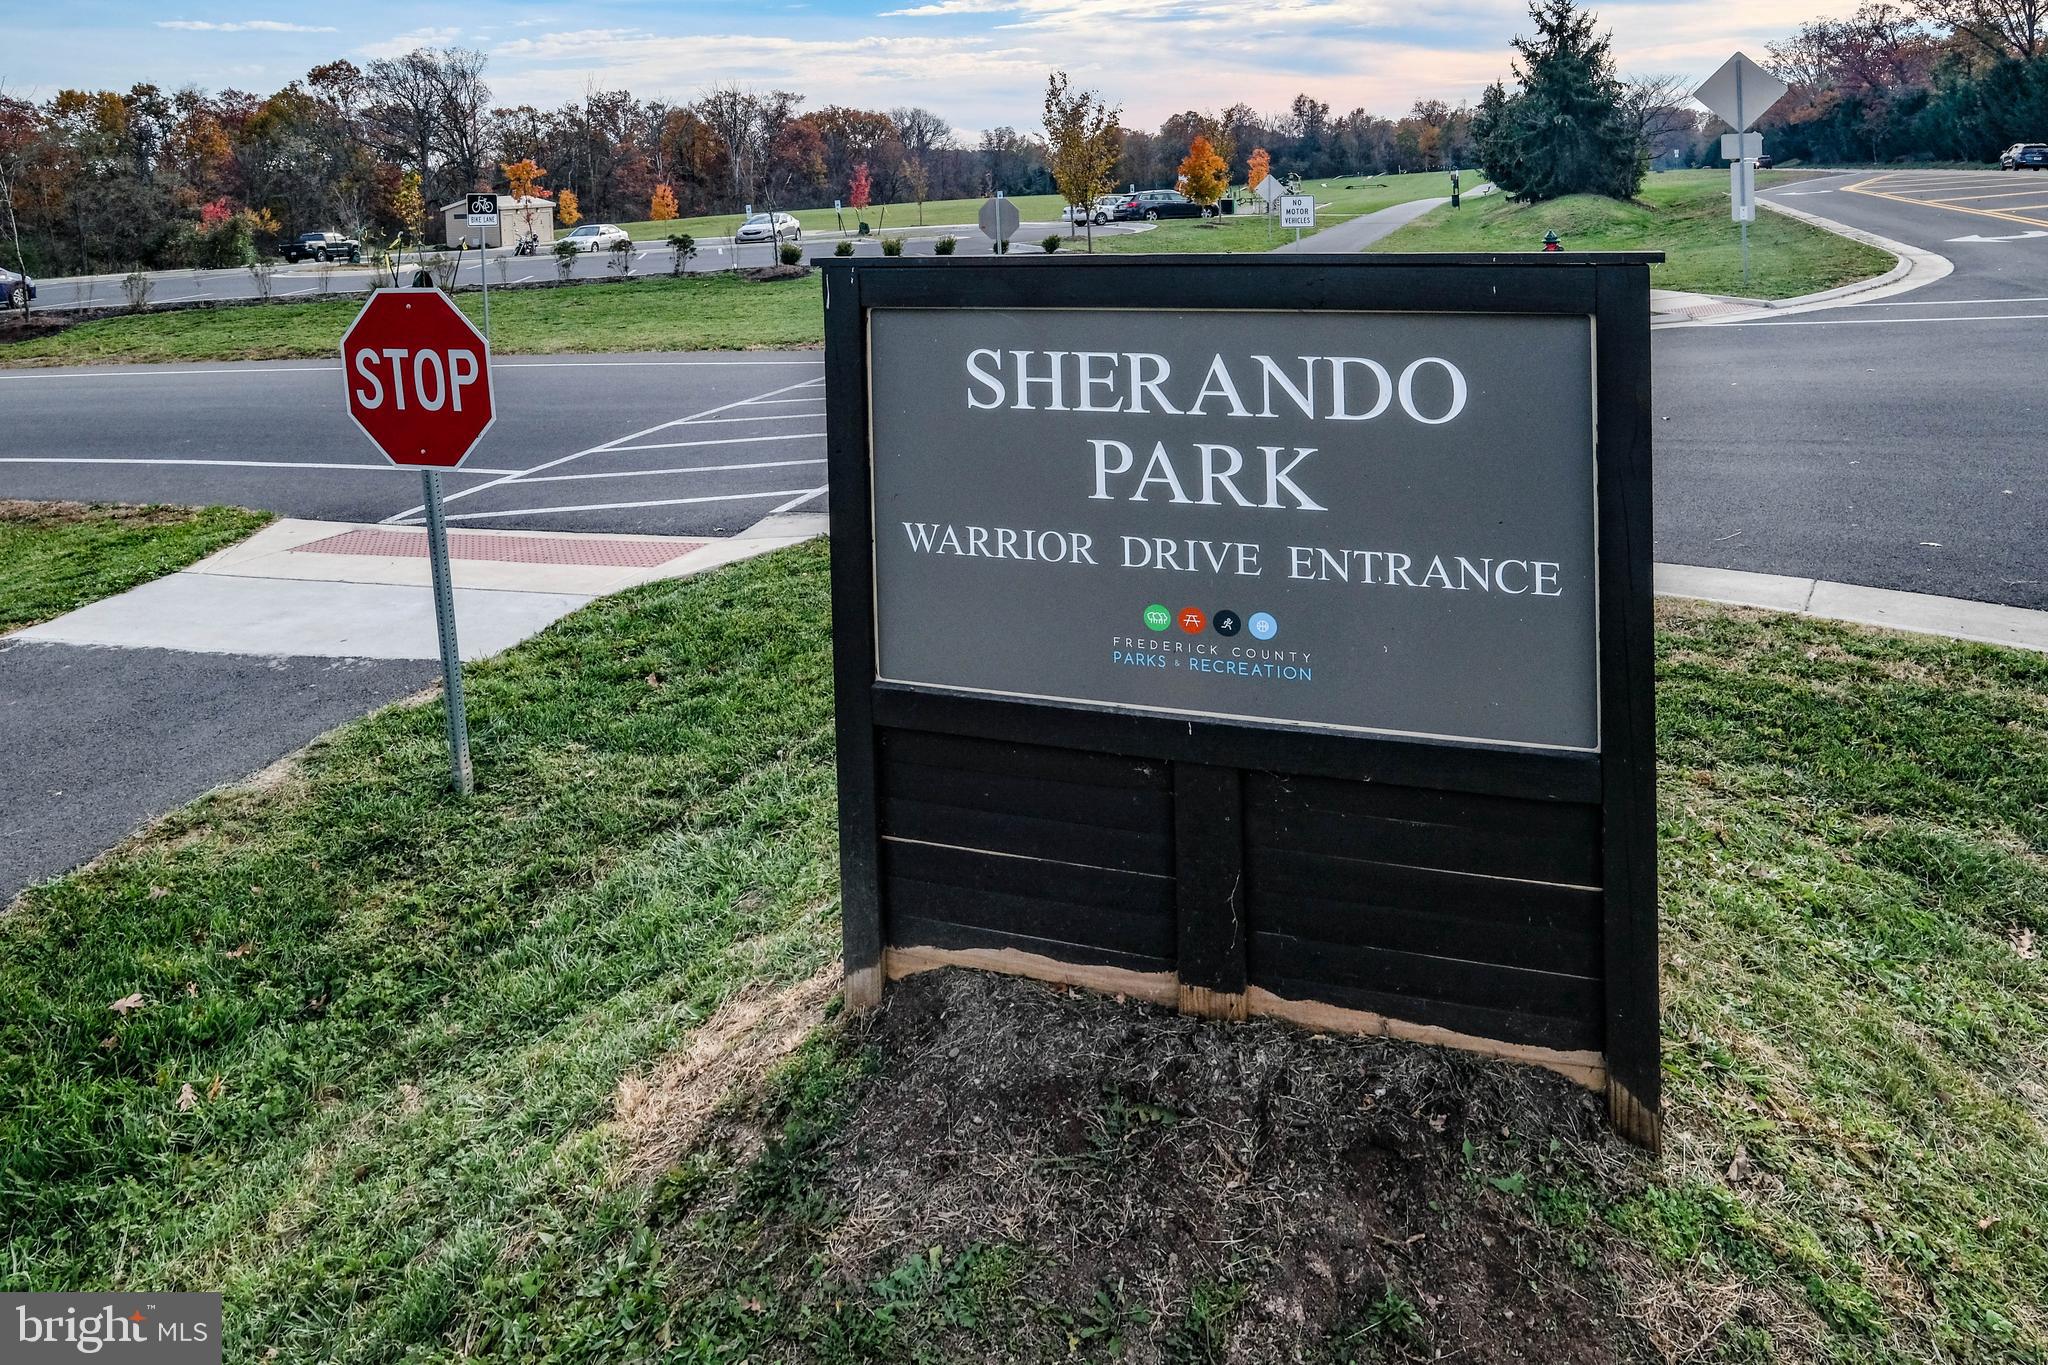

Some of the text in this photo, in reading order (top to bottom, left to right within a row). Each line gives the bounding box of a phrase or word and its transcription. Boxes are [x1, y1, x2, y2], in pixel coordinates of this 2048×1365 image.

[483, 215, 495, 223] LANE
[355, 346, 480, 413] STOP
[966, 347, 1469, 426] SHERANDO
[1087, 438, 1328, 512] PARK
[902, 521, 1563, 598] WARRIOR DRIVE ENTRANCE
[1112, 636, 1312, 663] FREDERICK COUNTY
[1112, 651, 1313, 681] PARKS & RECREATION
